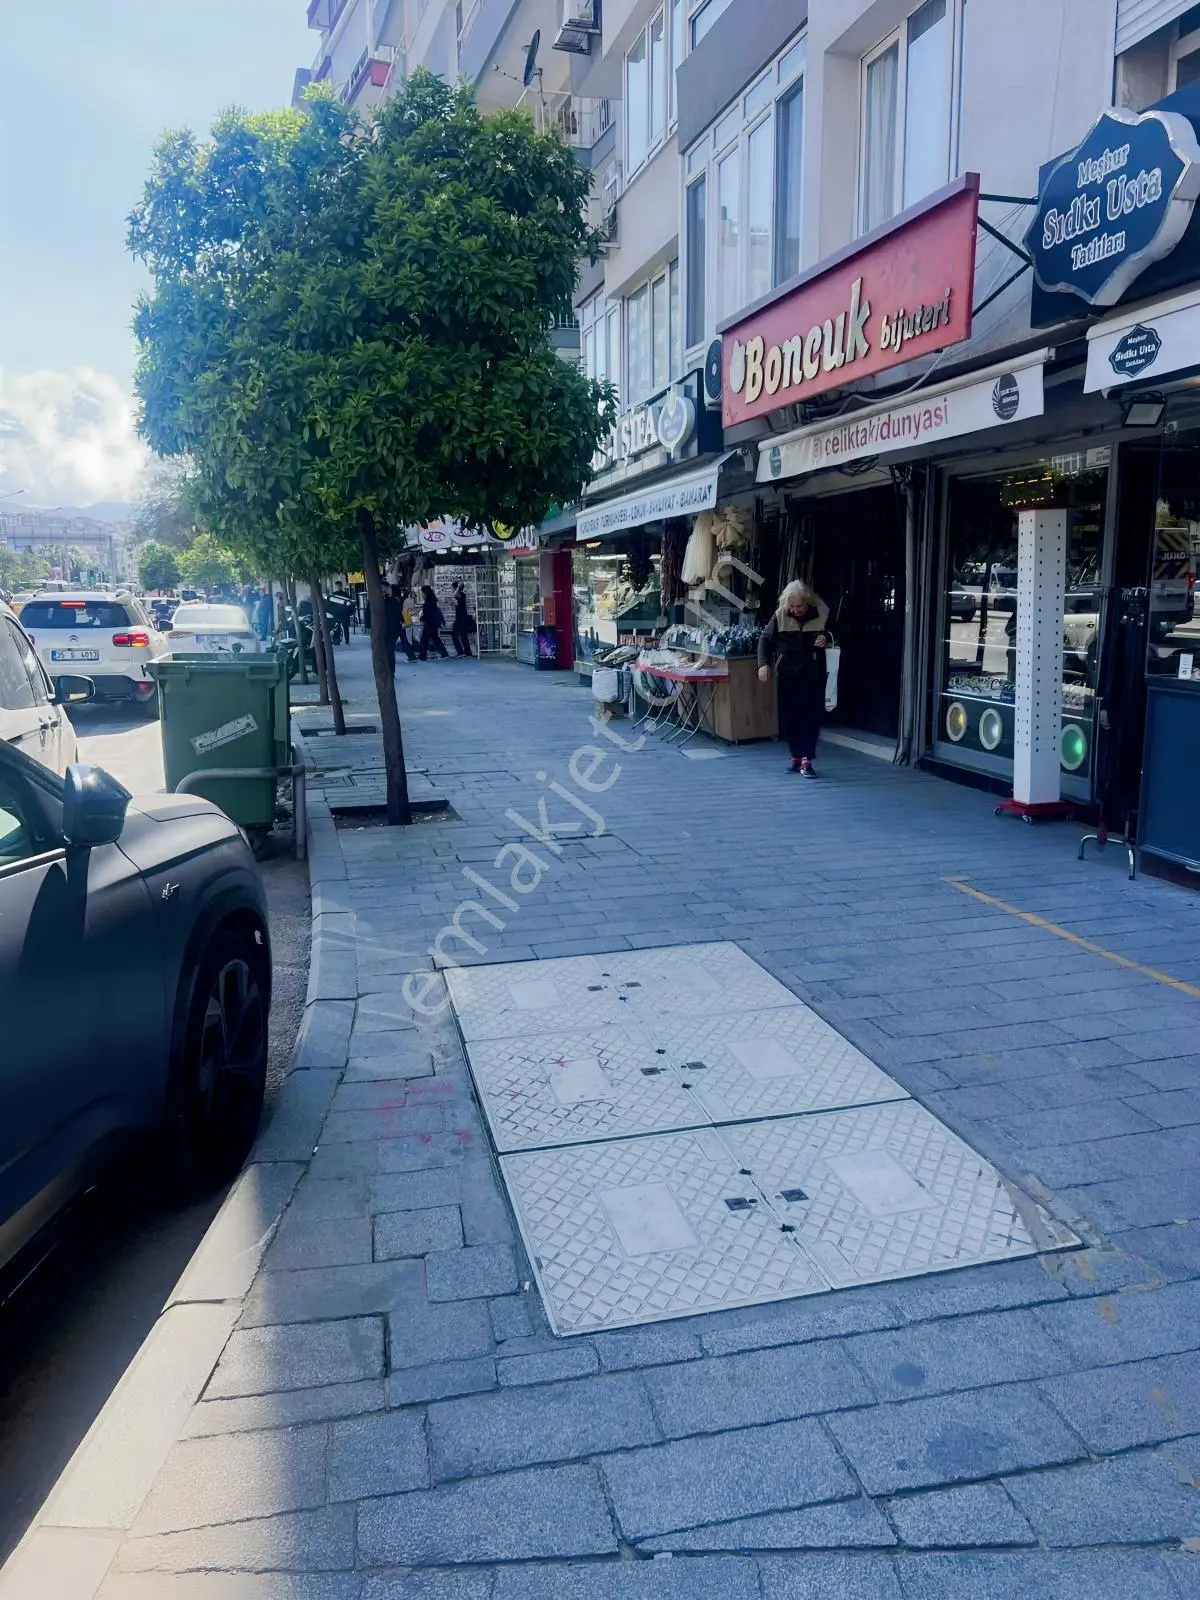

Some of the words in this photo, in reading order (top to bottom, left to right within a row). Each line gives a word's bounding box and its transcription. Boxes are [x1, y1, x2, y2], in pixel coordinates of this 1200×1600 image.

[1077, 144, 1130, 188] Meşhur
[1043, 193, 1100, 250] Sıdkı
[1107, 168, 1162, 220] Usta
[1071, 231, 1126, 271] Tatlıları
[745, 277, 872, 404] Boncuk
[880, 288, 952, 353] bijuteri
